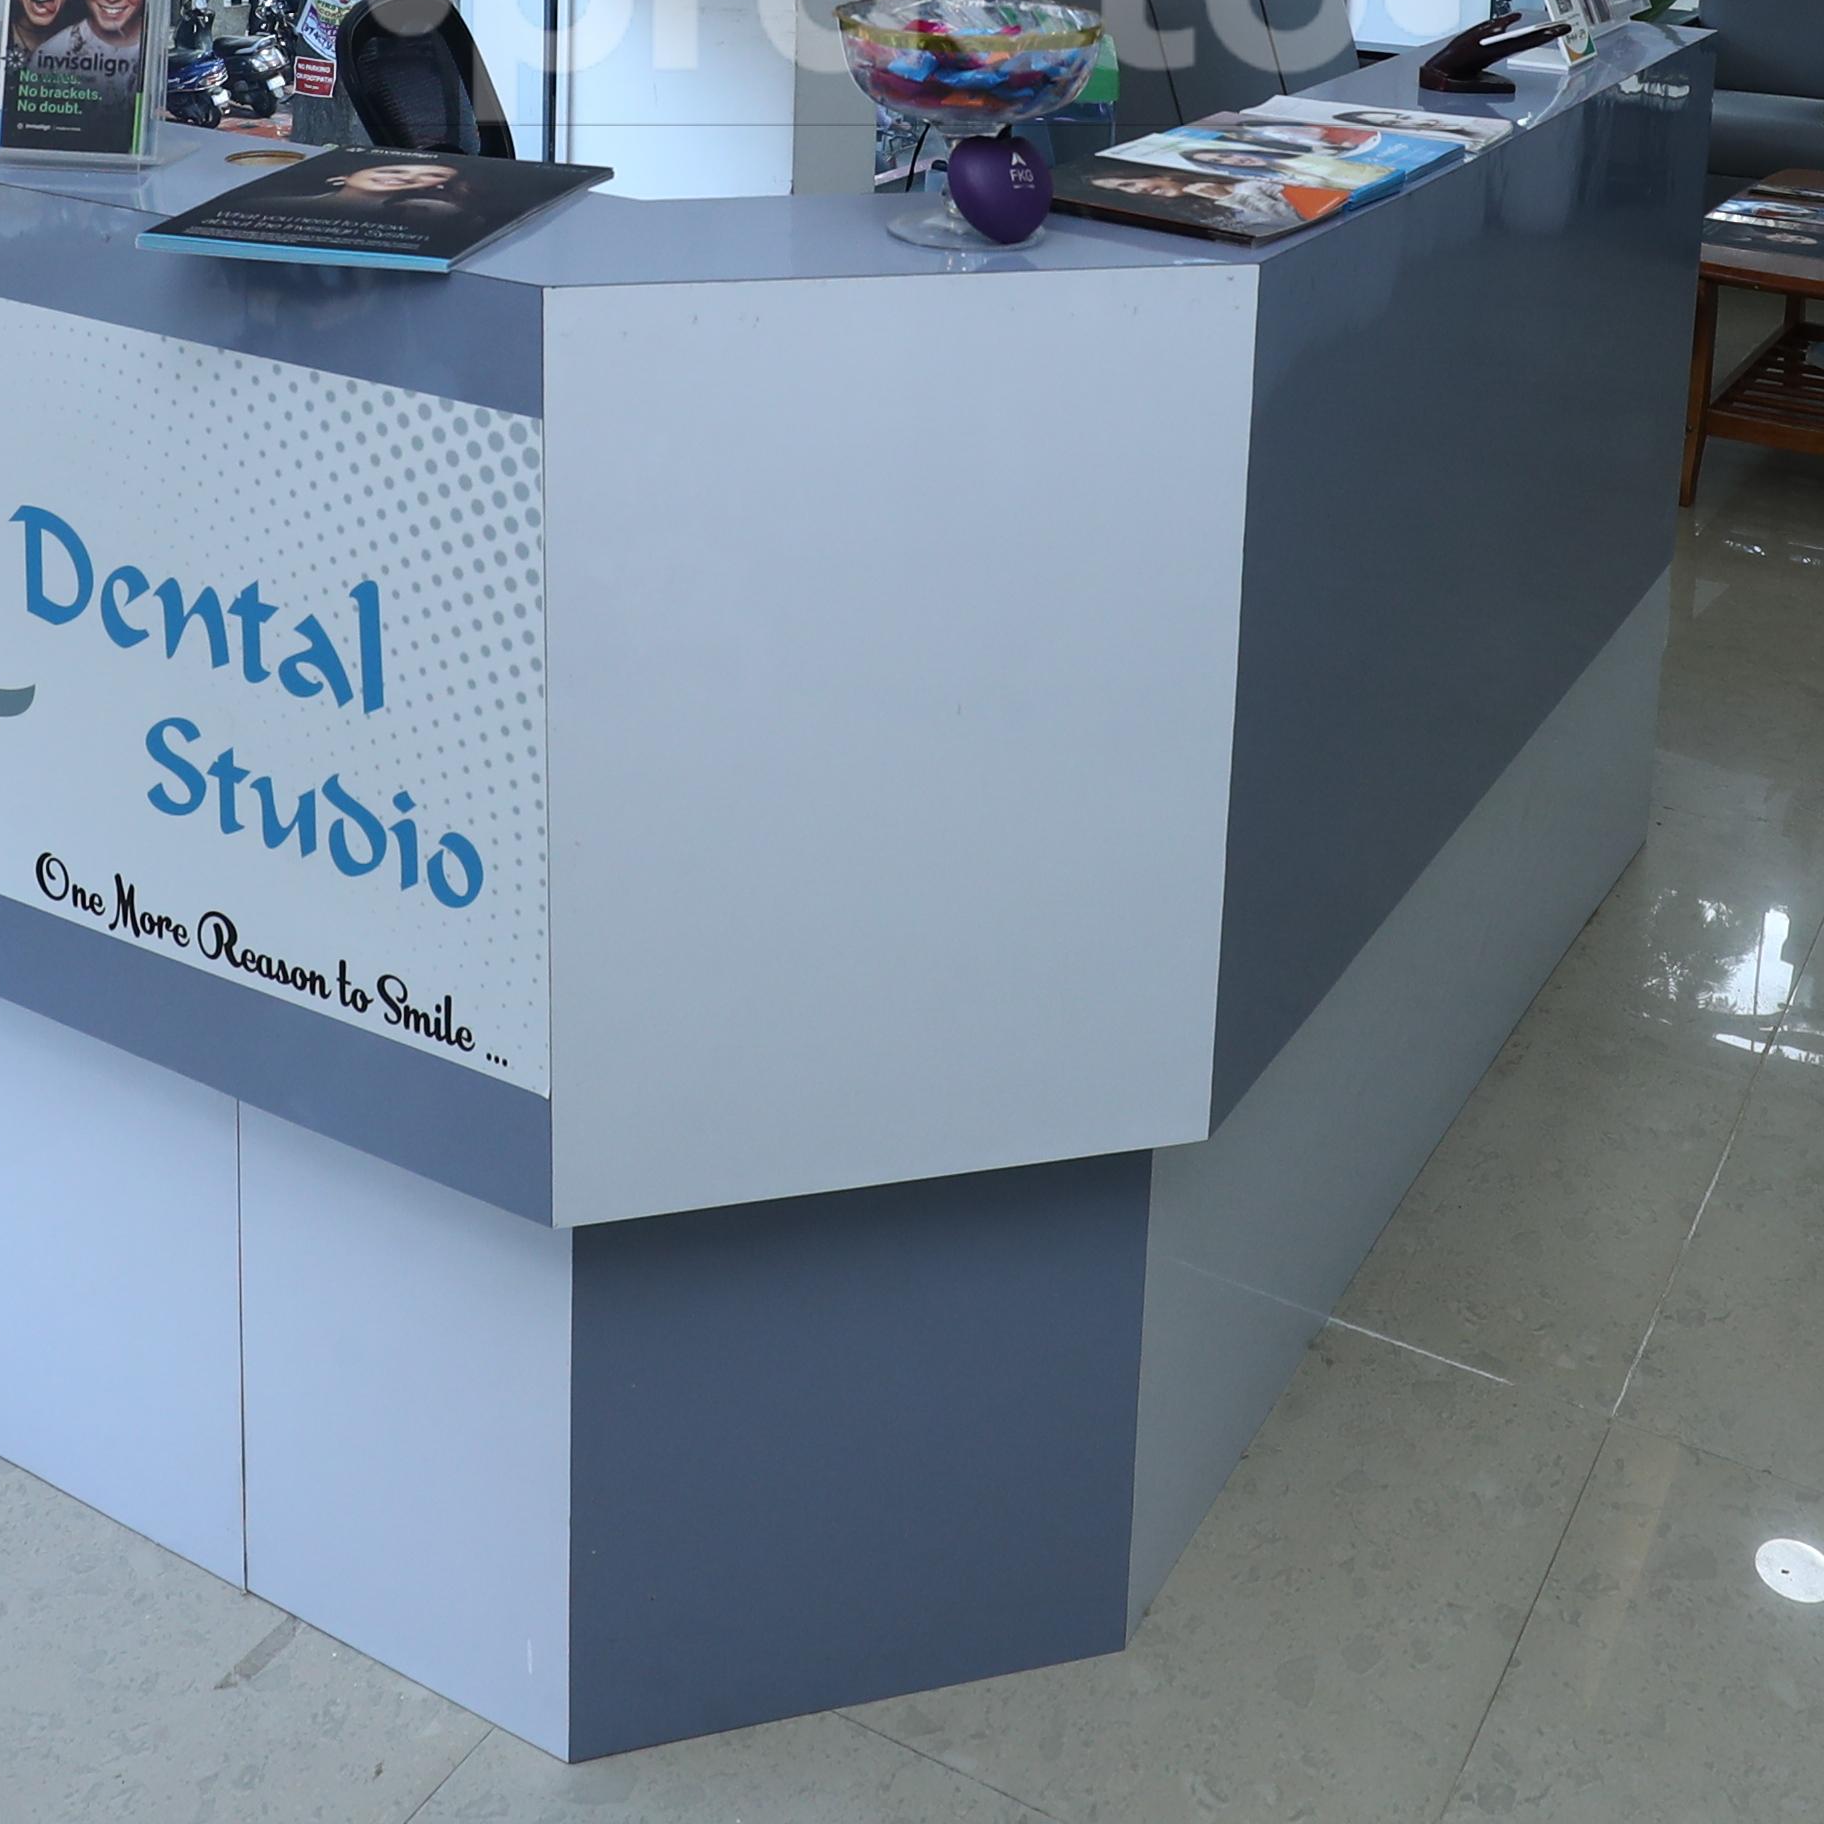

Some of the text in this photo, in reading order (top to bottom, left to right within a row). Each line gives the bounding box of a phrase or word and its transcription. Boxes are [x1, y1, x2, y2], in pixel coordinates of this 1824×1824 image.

[37, 50, 129, 77] invisalign
[19, 69, 38, 83] No
[18, 84, 103, 101] No brackets.
[17, 100, 83, 115] No doubt.
[1009, 168, 1034, 183] FKG
[8, 503, 387, 716] Dental
[143, 716, 485, 910] Studio
[35, 851, 106, 917] One
[107, 872, 191, 948] More
[196, 910, 333, 999] Reason
[336, 959, 374, 1013] to
[376, 974, 476, 1052] Smile
